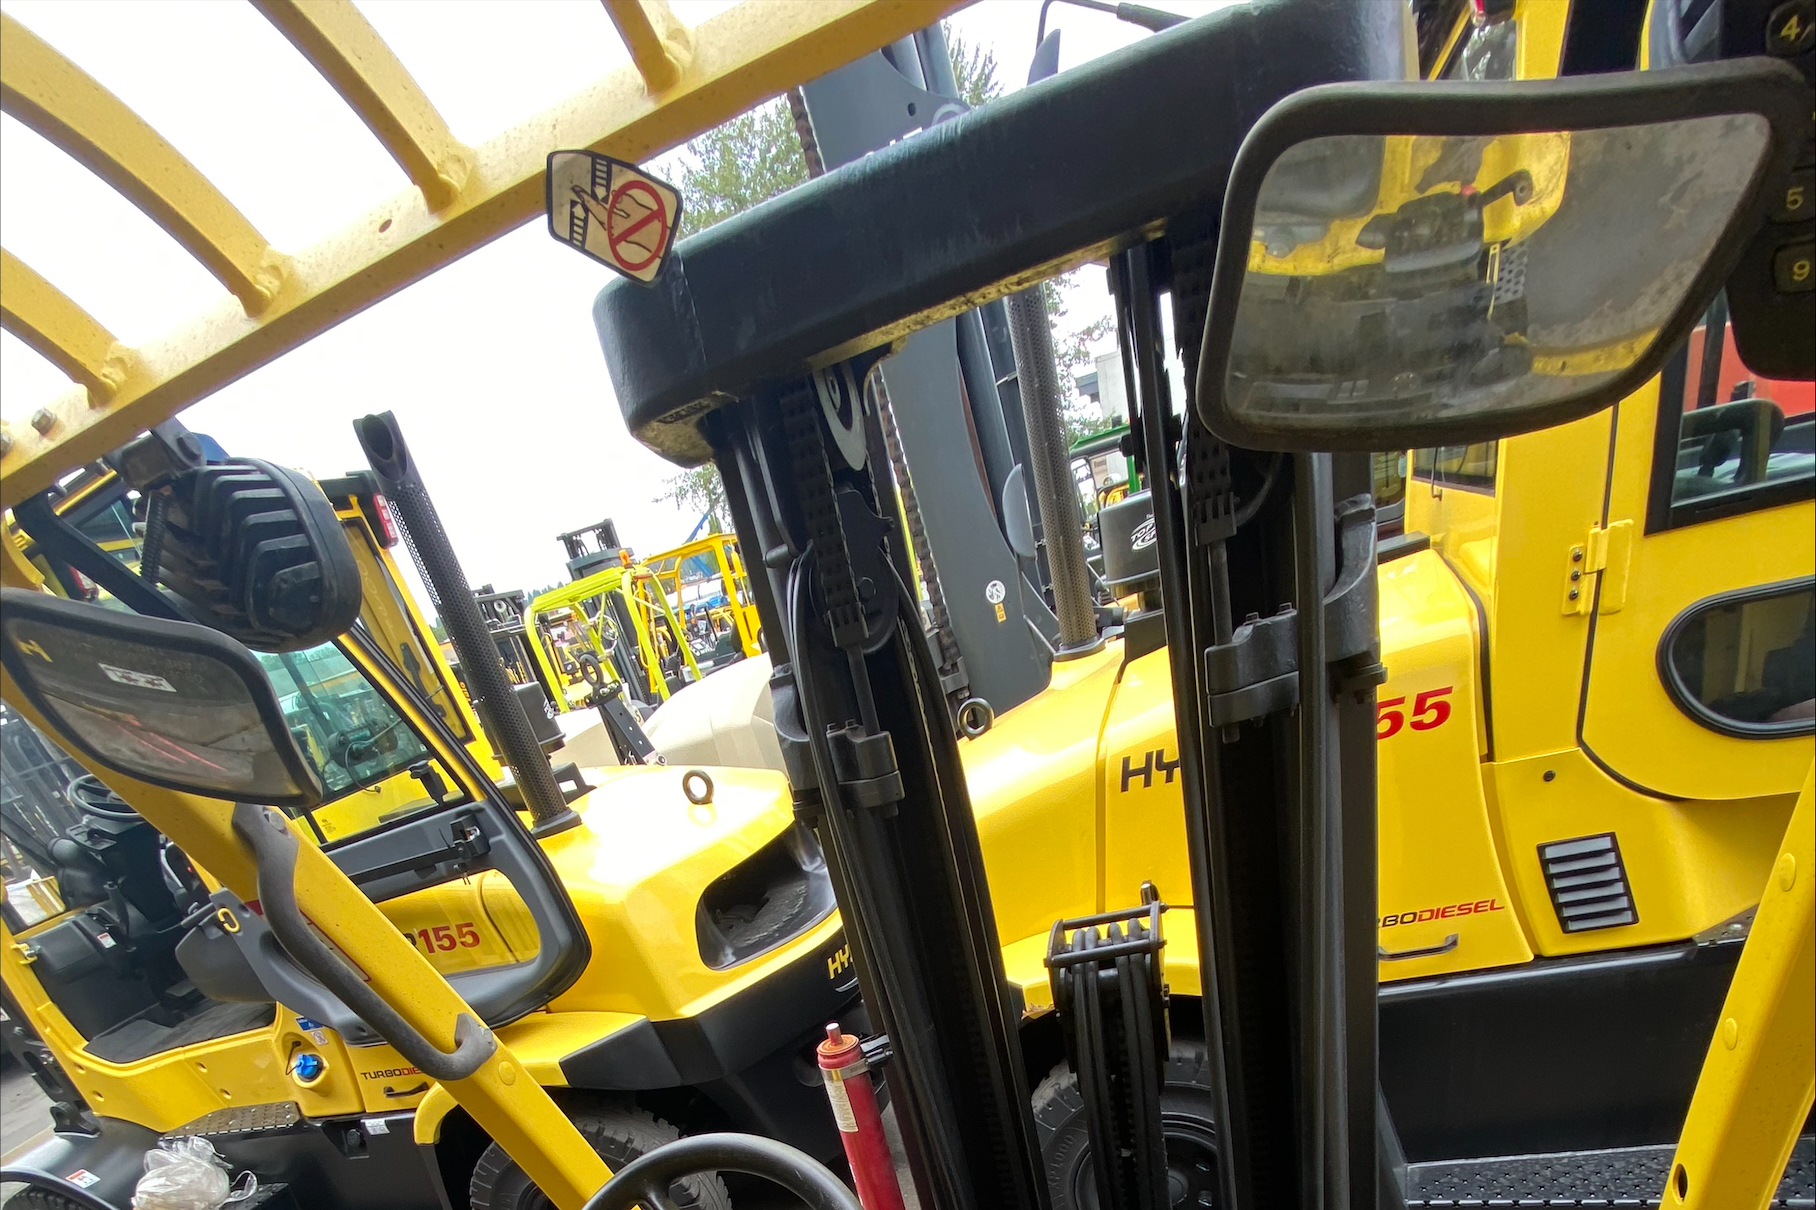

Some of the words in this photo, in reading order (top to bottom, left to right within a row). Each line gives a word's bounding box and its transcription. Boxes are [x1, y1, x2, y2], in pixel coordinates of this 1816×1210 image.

[1786, 186, 1804, 210] 5
[1793, 260, 1810, 281] 9
[1377, 899, 1505, 928] BODIESEL
[827, 943, 854, 980] HY
